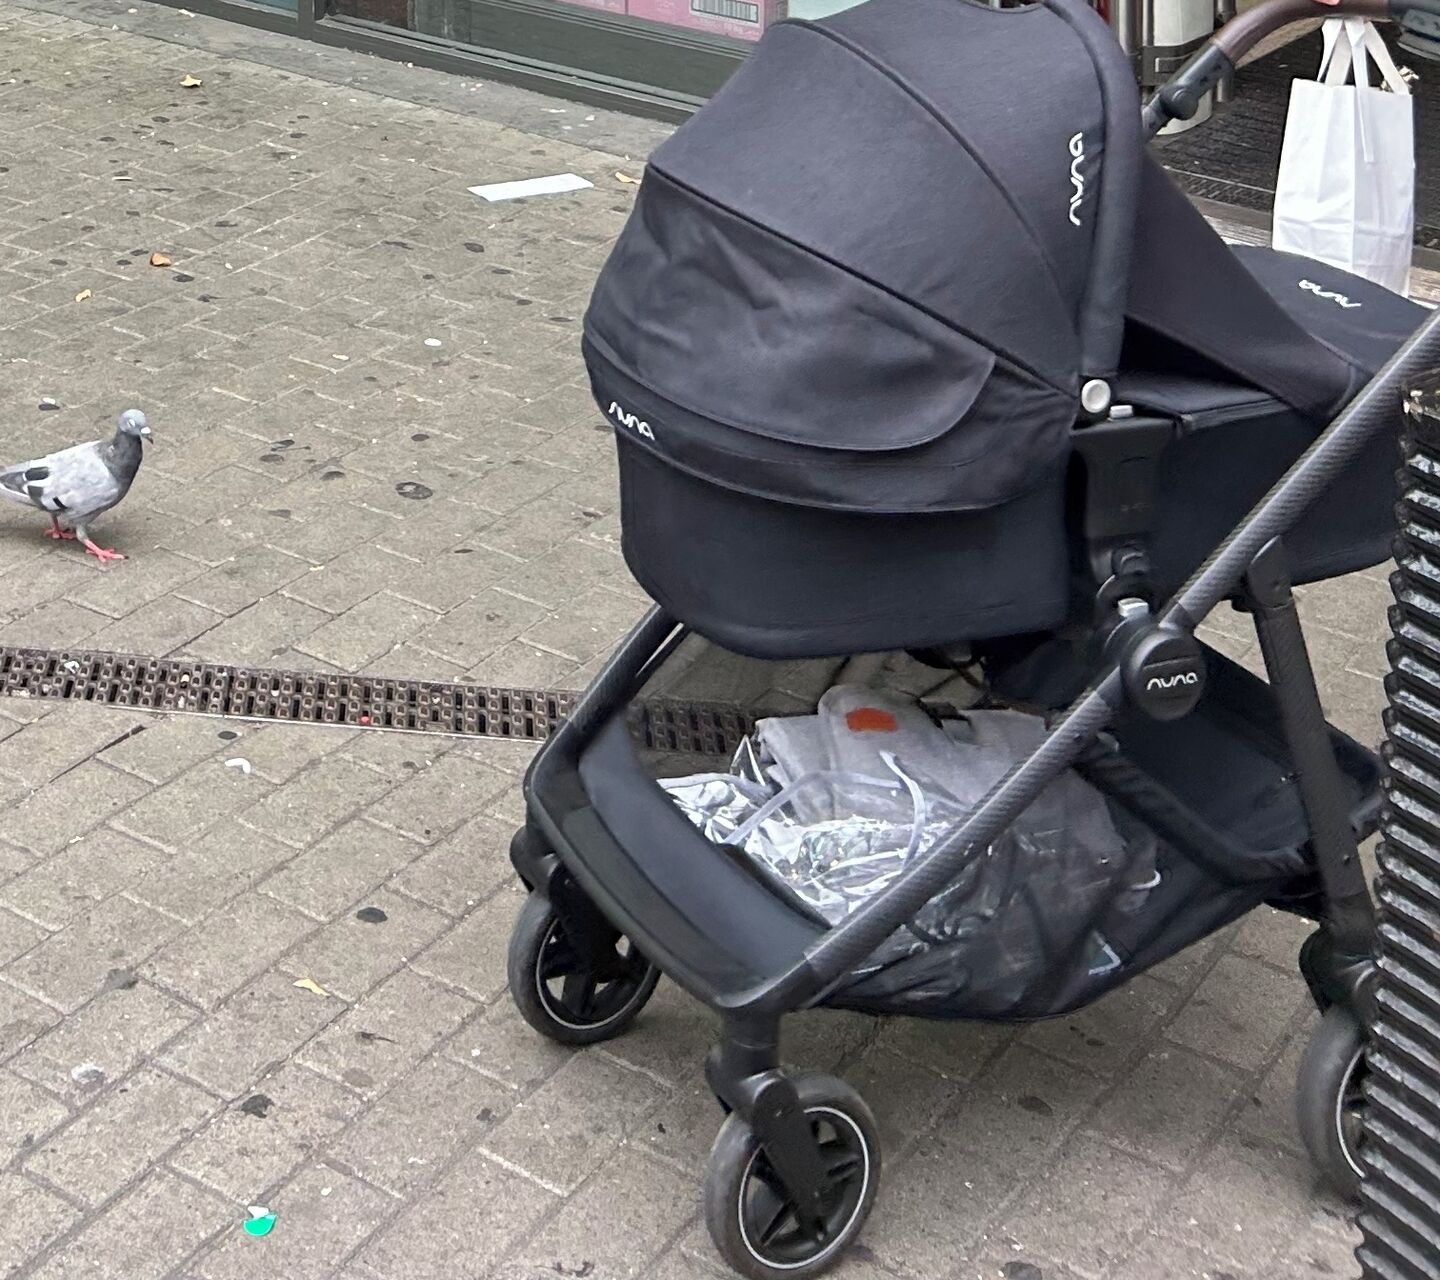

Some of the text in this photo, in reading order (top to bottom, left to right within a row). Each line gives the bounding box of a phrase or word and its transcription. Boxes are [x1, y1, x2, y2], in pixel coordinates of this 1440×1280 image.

[1069, 132, 1084, 226] nuna
[1298, 279, 1362, 308] nuna
[608, 401, 655, 441] nuna
[1146, 672, 1198, 690] nuna
